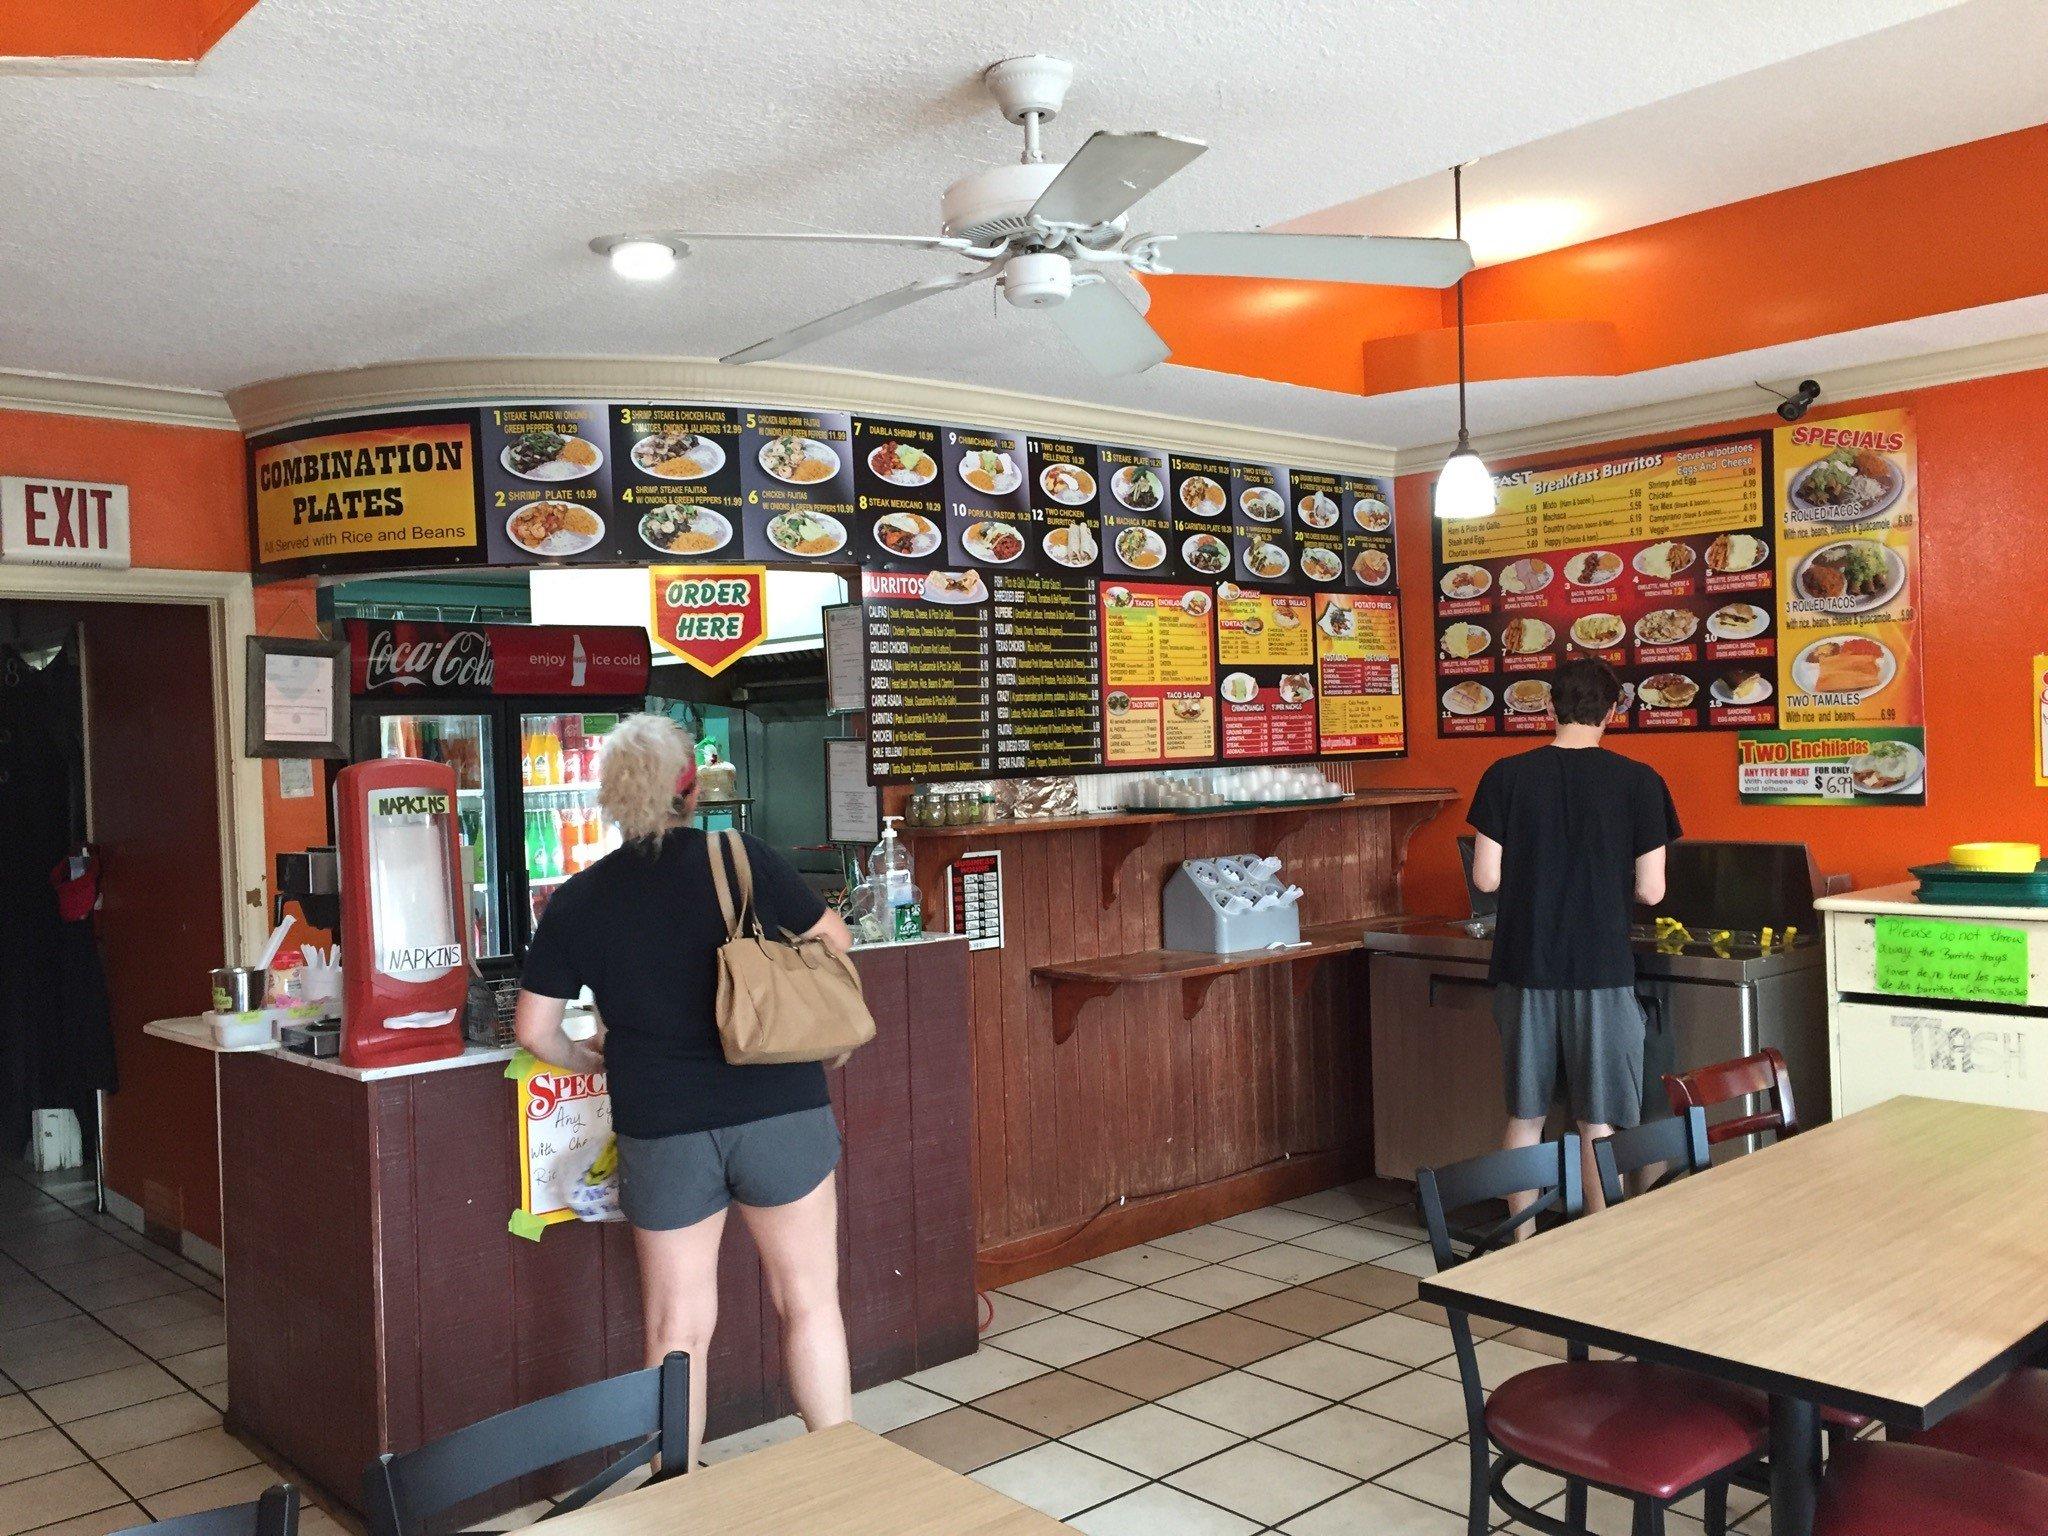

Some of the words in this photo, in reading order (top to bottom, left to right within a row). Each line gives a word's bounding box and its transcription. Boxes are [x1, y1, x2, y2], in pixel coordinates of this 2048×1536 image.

[494, 411, 501, 425] 1
[621, 409, 631, 424] 3
[746, 414, 756, 428] 5
[556, 424, 577, 434] 10.29
[722, 425, 742, 433] 12.99
[853, 423, 862, 436] 7
[870, 426, 892, 436] DIABLA
[893, 428, 917, 438] SHRIMP
[918, 431, 934, 440] 10.99
[949, 432, 956, 445] 9
[1792, 426, 1904, 453] SPECIALS
[1028, 441, 1038, 453] 11
[1041, 443, 1053, 451] TWO
[1055, 444, 1073, 453] CHILES
[1043, 453, 1070, 462] RELLENOS
[1102, 451, 1112, 462] 13
[1677, 451, 1705, 462] Served
[260, 442, 462, 491] COMBINATION
[1172, 459, 1181, 470] 15
[1203, 464, 1217, 473] PLATE
[1677, 464, 1697, 476] Eggs
[1722, 457, 1752, 468] Cheese
[1232, 468, 1241, 478] 17
[1533, 469, 1600, 495] Breakfast
[1602, 456, 1662, 478] Burritos
[1291, 476, 1299, 485] 19
[1345, 482, 1353, 490] 21
[1649, 479, 1670, 490] Shrimp
[1671, 478, 1682, 486] and
[1684, 476, 1697, 487] Egg
[495, 491, 506, 507] 2
[508, 491, 540, 500] SHRIMP
[546, 491, 572, 499] PLATE
[576, 490, 597, 499] 10.99
[622, 488, 633, 503] 4
[724, 497, 742, 506] 11.99
[748, 490, 758, 504] 6
[1649, 492, 1673, 500] Chicken
[293, 487, 404, 525] PLATES
[837, 504, 854, 513] 10.99
[859, 495, 867, 509] 8
[869, 498, 889, 507] STEAK
[891, 500, 923, 509] MEXICANO
[926, 502, 942, 512] 10.29
[952, 503, 966, 516] 10
[993, 510, 1016, 520] PASTOR
[1032, 509, 1044, 520] 12
[1045, 508, 1058, 516] TWO
[1060, 509, 1084, 518] CHICKEN
[1784, 514, 1788, 523] 5
[1790, 507, 1826, 523] ROLLED
[1829, 503, 1860, 517] TACOS
[24, 484, 112, 550] EXIT
[1104, 515, 1114, 526] 14
[1141, 519, 1156, 528] PLATE
[1174, 520, 1184, 531] 16
[1207, 524, 1221, 532] PLATE
[1236, 526, 1245, 535] 18
[1649, 526, 1670, 535] Veggie
[1858, 519, 1890, 535] guacamole
[275, 536, 309, 550] Served
[313, 531, 336, 546] with
[342, 530, 373, 544] Rice
[378, 527, 406, 541] and
[413, 524, 465, 539] Beans
[1295, 532, 1304, 541] 20
[862, 572, 925, 595] BURRITOS
[666, 581, 750, 607] ORDER
[1377, 602, 1392, 610] FRIES
[1786, 601, 1790, 613] 3
[1792, 598, 1824, 612] ROLLED
[1827, 596, 1856, 609] TACOS
[677, 615, 742, 639] HERE
[1860, 613, 1891, 628] guacamole
[869, 624, 890, 636] CHICAGO
[1634, 639, 1641, 648] 9
[1704, 634, 1717, 642] 10
[1566, 643, 1573, 652] 8
[366, 630, 495, 690] Coca-Cola
[529, 654, 566, 667] enjoy
[592, 653, 611, 666] ice
[613, 653, 641, 666] cold
[1787, 695, 1809, 707] TWO
[1812, 694, 1860, 705] TAMALES
[1504, 708, 1514, 716] 12
[1786, 712, 1801, 723] With
[1802, 712, 1815, 722] rice
[1819, 711, 1831, 722] and
[1835, 711, 1856, 721] beans
[1880, 709, 1896, 721] 6.99
[1790, 738, 1870, 760] Enchiladas
[1744, 768, 1759, 777] ANY
[1760, 768, 1778, 777] TYPE
[1779, 768, 1789, 776] OF
[1790, 767, 1810, 776] MEAT
[1831, 766, 1850, 774] ONLY
[1795, 778, 1808, 786] dip
[1814, 775, 1823, 790] $
[1826, 776, 1854, 794] 6.99
[379, 795, 447, 815] NAPKINS
[1888, 919, 1932, 939] Please
[1940, 928, 1956, 942] do
[1959, 930, 1980, 941] not
[389, 946, 461, 970] NAPKINS
[1919, 946, 1935, 957] the
[1917, 967, 1928, 978] de
[1916, 985, 1953, 994] burritos
[555, 1107, 586, 1134] Any
